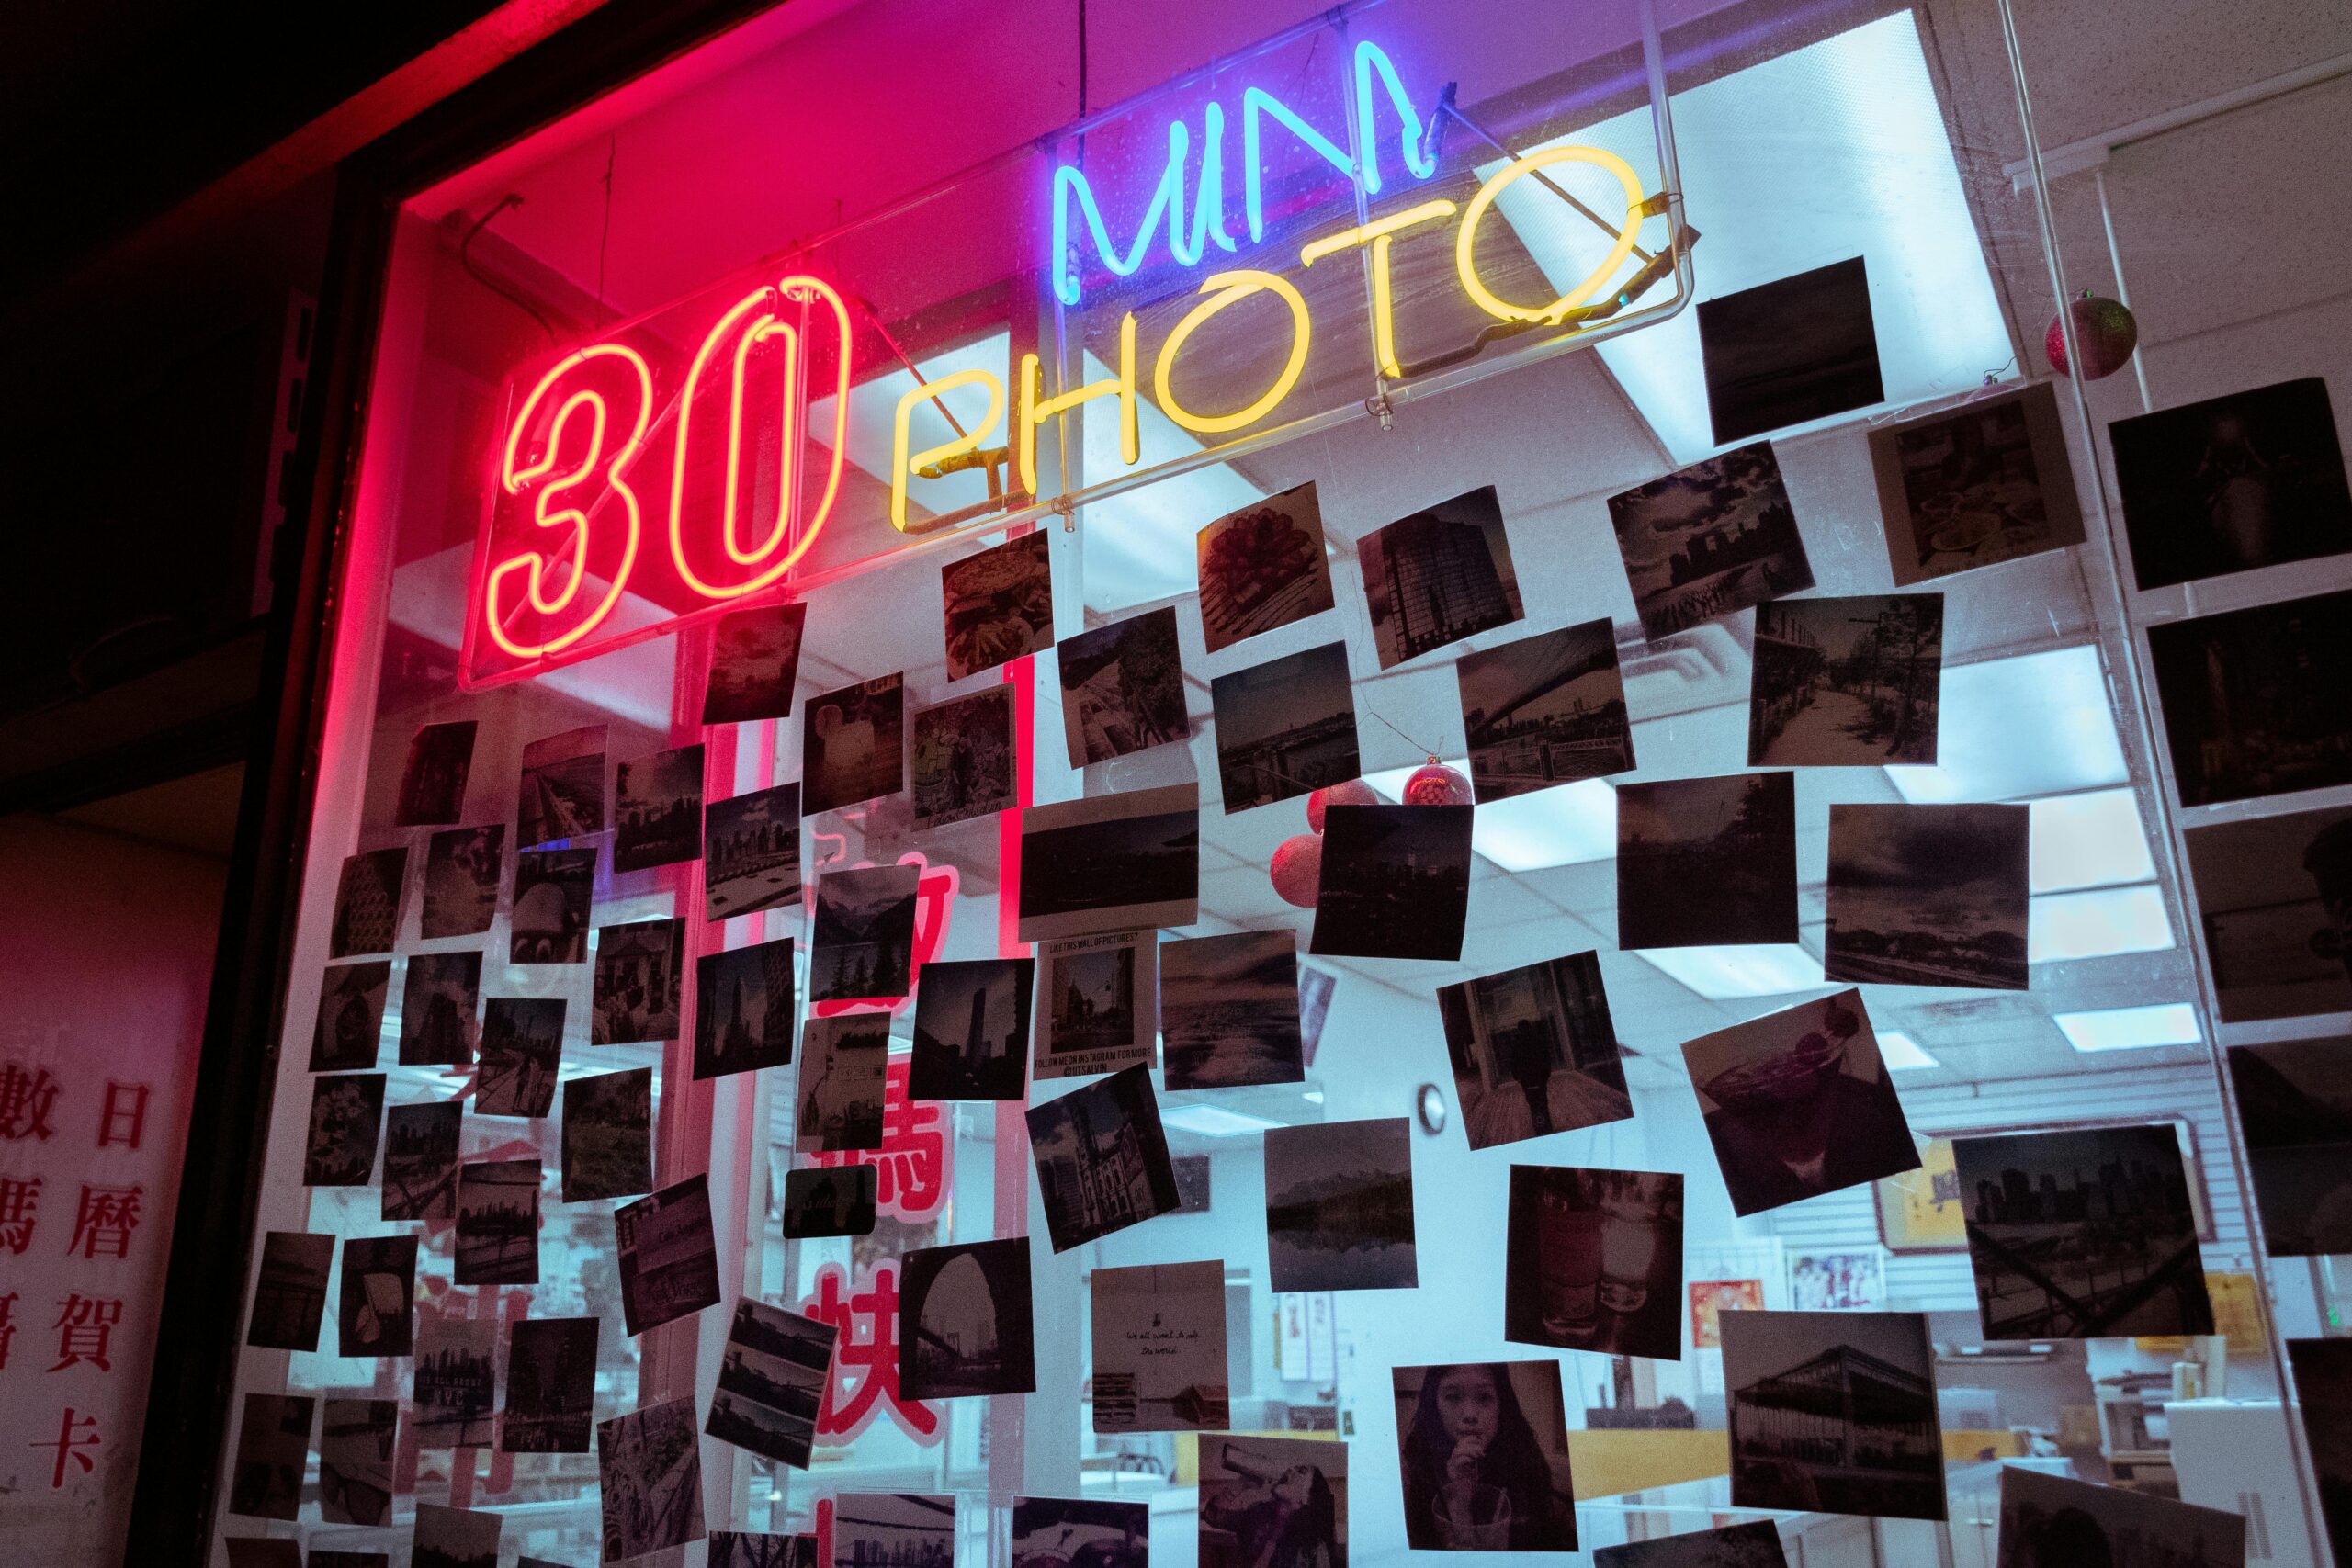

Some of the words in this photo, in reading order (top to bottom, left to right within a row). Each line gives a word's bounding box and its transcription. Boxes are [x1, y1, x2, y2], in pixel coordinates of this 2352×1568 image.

[486, 275, 853, 659] 30
[891, 145, 1645, 533] PHOTO
[1035, 1057, 1058, 1068] FOLLOW
[1058, 1055, 1068, 1066] ME
[1069, 1055, 1078, 1064] ON
[1078, 1051, 1116, 1063] INSTAGRAM
[1117, 1049, 1131, 1059] FOR
[1131, 1047, 1151, 1057] MORE
[1049, 943, 1063, 953] LIKE
[1063, 942, 1078, 952] THIS
[1078, 939, 1093, 949] WALL
[1094, 937, 1102, 946] OF
[1102, 932, 1138, 945] PICTURES?
[28, 1078, 153, 1490] 日曆賀卡
